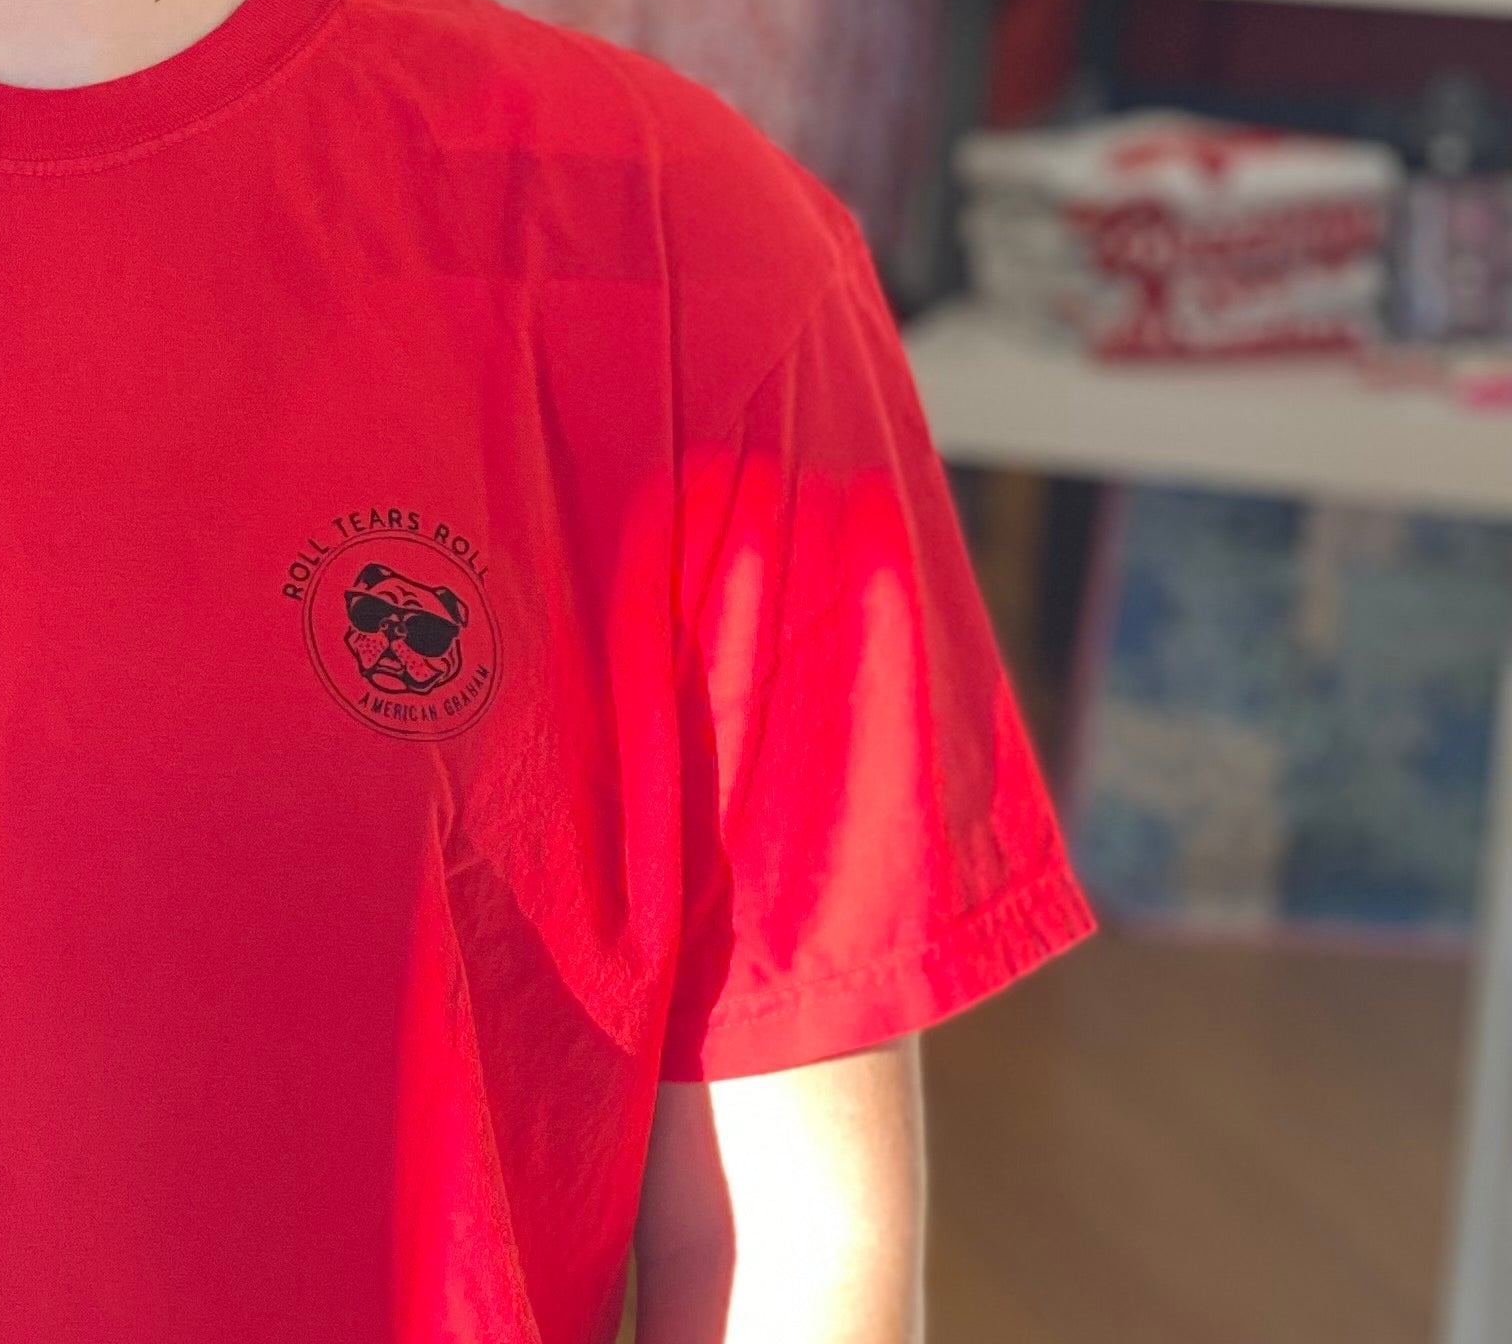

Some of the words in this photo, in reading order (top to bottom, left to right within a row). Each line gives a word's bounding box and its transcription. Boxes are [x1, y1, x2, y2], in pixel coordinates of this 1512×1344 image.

[282, 538, 330, 601] ROLL
[332, 507, 420, 538] TEARS
[434, 523, 489, 585] ROLL
[358, 691, 438, 722] AMERICAN
